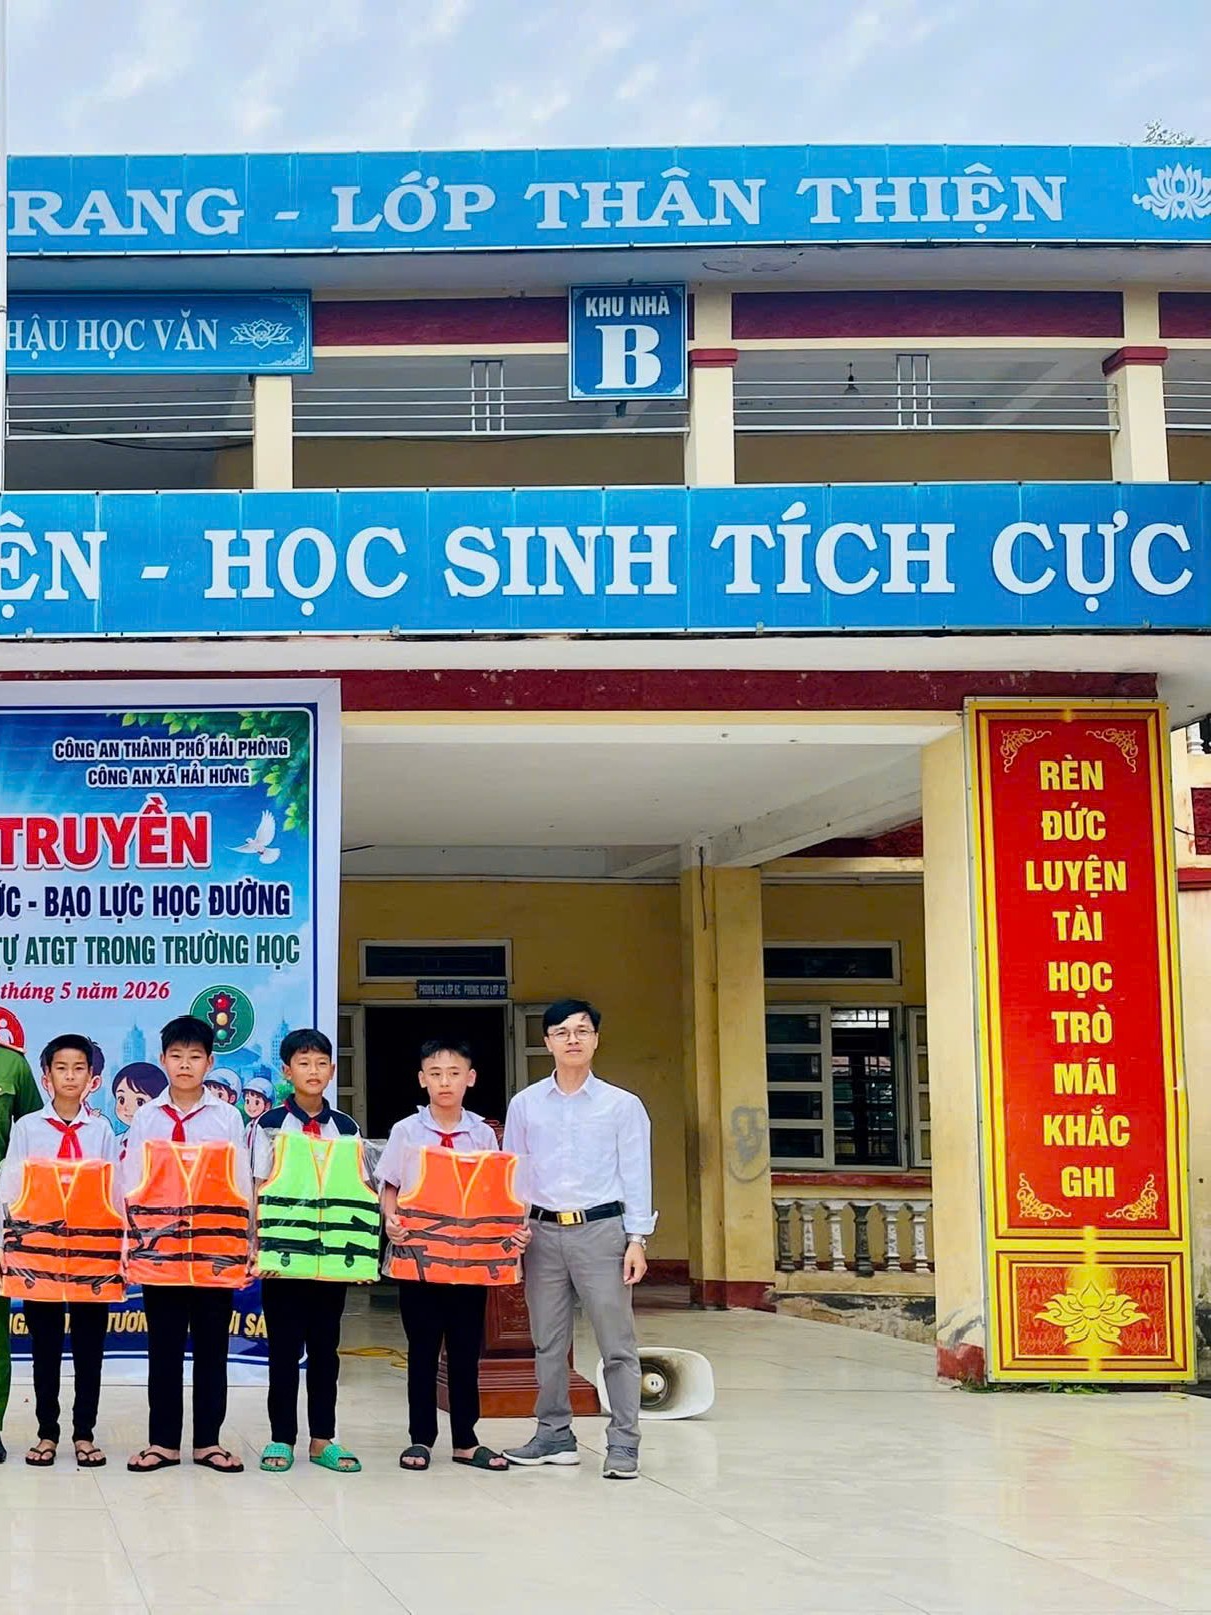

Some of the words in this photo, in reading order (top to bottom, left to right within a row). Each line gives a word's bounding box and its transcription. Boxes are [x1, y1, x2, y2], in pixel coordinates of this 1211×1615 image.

[331, 171, 496, 233] LỚP
[524, 167, 766, 229] THÂN
[796, 163, 1067, 233] THIỆN
[585, 296, 625, 317] KHU
[630, 291, 670, 316] NHÀ
[6, 312, 69, 361] HẬU
[75, 319, 147, 361] HỌC
[155, 309, 219, 352] VĂN
[594, 324, 662, 389] B
[204, 527, 408, 616] HỌC
[444, 525, 678, 598] SINH
[710, 501, 956, 596] TÍCH
[992, 510, 1194, 612] CỰC
[54, 738, 95, 759] CÔNG
[98, 742, 120, 759] AN
[124, 738, 171, 758] THÀNH
[175, 734, 208, 758] PHỐ
[210, 736, 234, 758] HẢI
[236, 736, 289, 757] PHÒNG
[88, 766, 128, 786] CÔNG
[131, 769, 152, 786] AN
[156, 764, 175, 785] XÃ
[180, 762, 205, 785] HẢI
[209, 767, 250, 784] HƯNG
[1040, 752, 1104, 790] RÈN
[1041, 803, 1106, 841] ĐỨC
[1025, 855, 1127, 898] LUYỆN
[44, 885, 91, 924] BẠO
[99, 882, 144, 924] LỰC
[152, 884, 200, 924] HỌC
[208, 877, 290, 916] ĐƯỜNG
[1052, 904, 1103, 941] TÀI
[24, 936, 78, 966] ATGT
[84, 936, 156, 965] TRONG
[162, 930, 249, 965] TRƯỜNG
[256, 934, 300, 970] HỌC
[0, 981, 56, 1004] tháng
[60, 982, 72, 1000] 5
[77, 982, 118, 1000] năm
[122, 981, 171, 1000] 2026
[1048, 961, 1113, 998] HỌC
[1051, 1005, 1113, 1044] TRÒ
[1053, 1057, 1116, 1095] MÃI
[1043, 1104, 1130, 1147] KHẮC
[1060, 1166, 1115, 1199] GHI
[106, 1310, 148, 1333] TƯƠN
